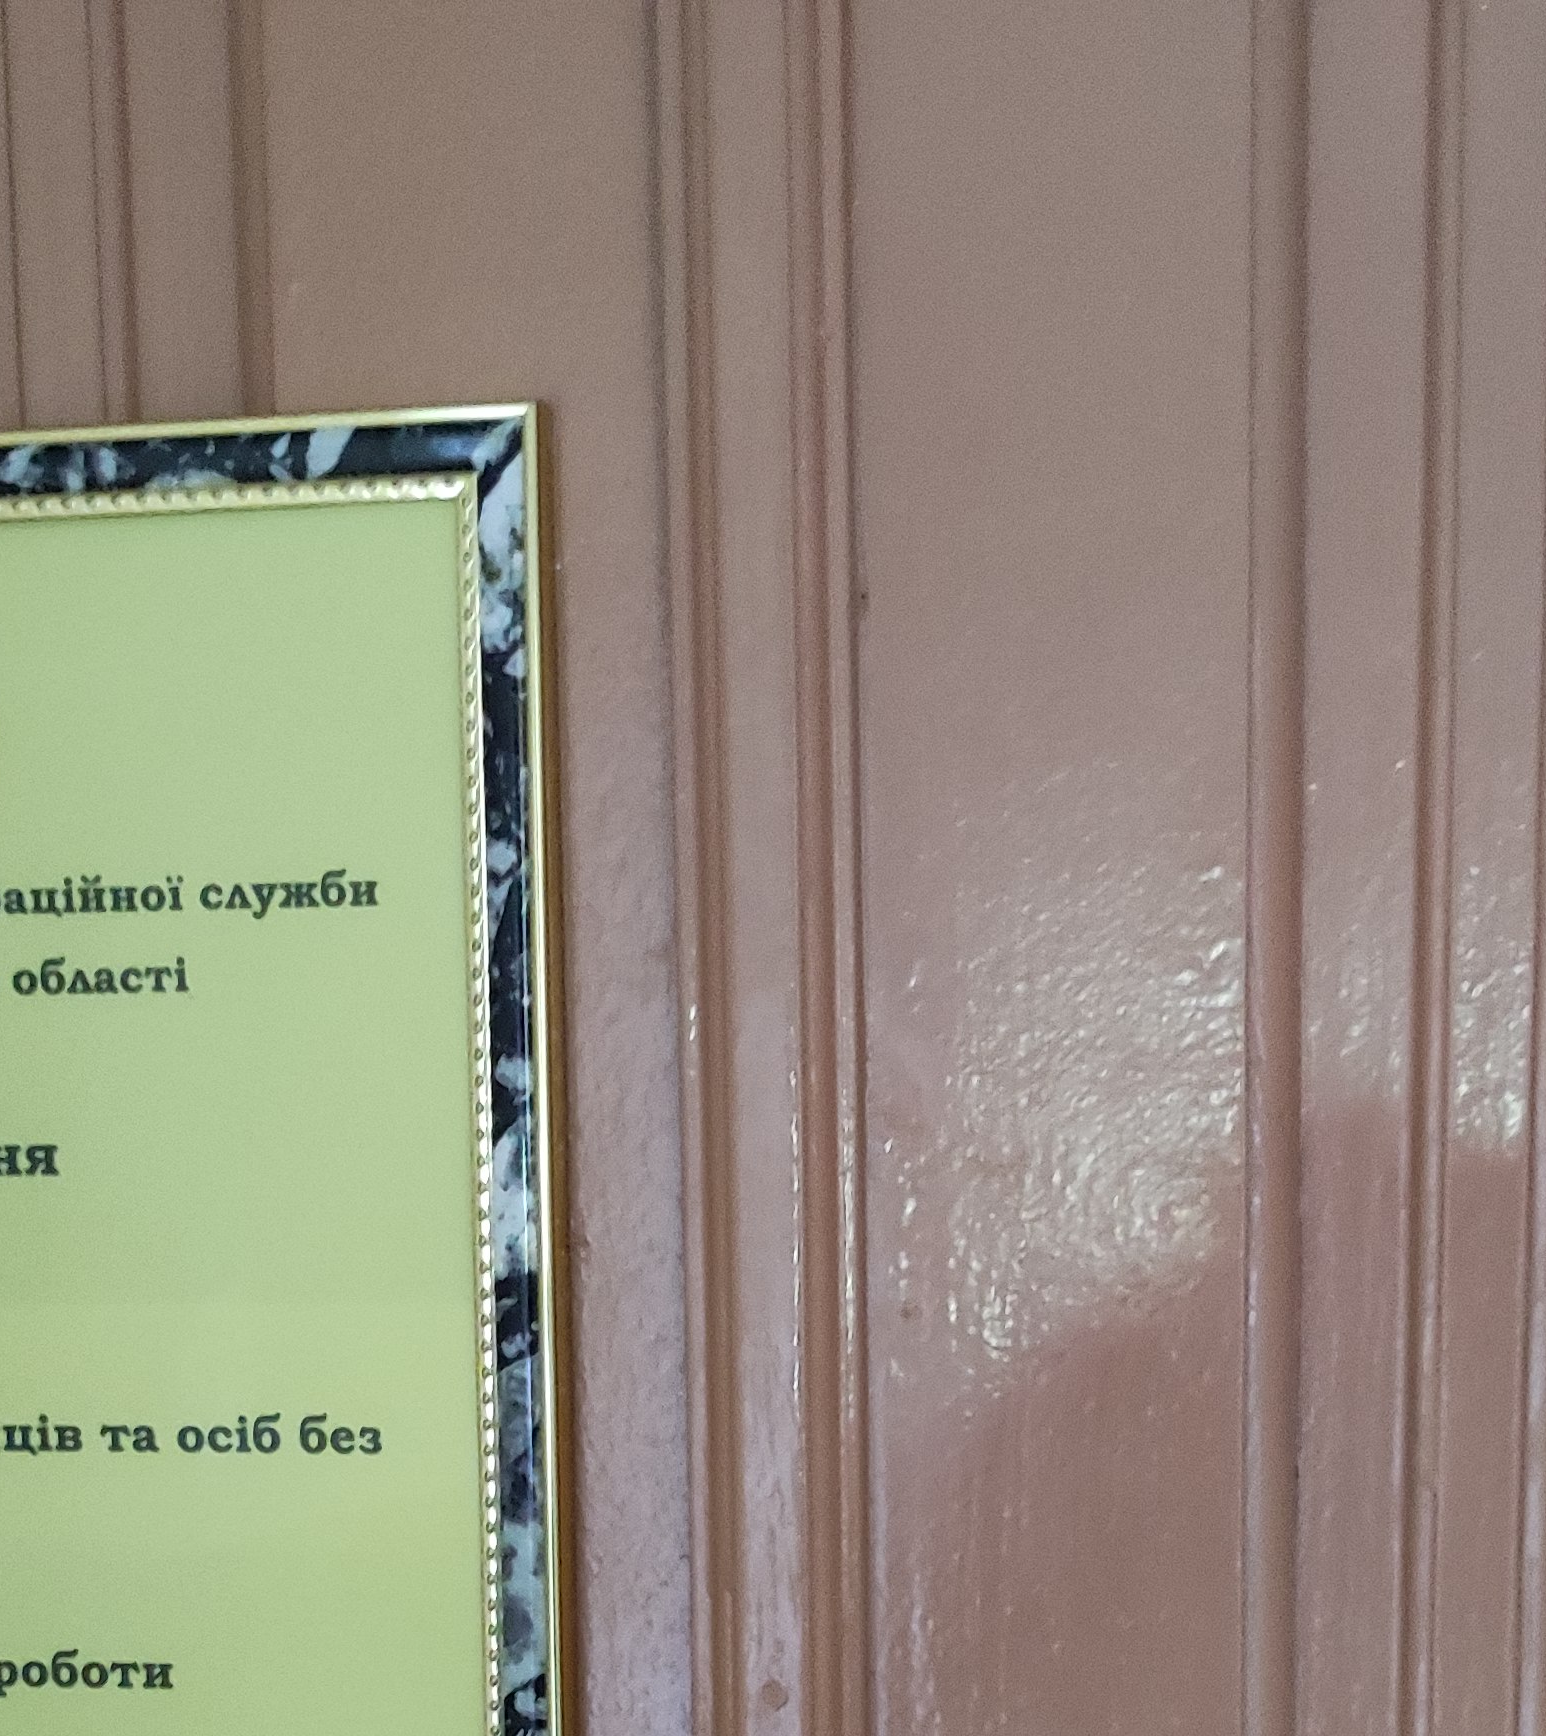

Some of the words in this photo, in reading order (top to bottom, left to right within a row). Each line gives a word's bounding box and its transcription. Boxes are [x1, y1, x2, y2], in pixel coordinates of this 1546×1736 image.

[199, 868, 379, 921] служби
[11, 956, 190, 997] області
[99, 1423, 161, 1454] та
[176, 1412, 282, 1455] осіб
[298, 1412, 383, 1456] без
